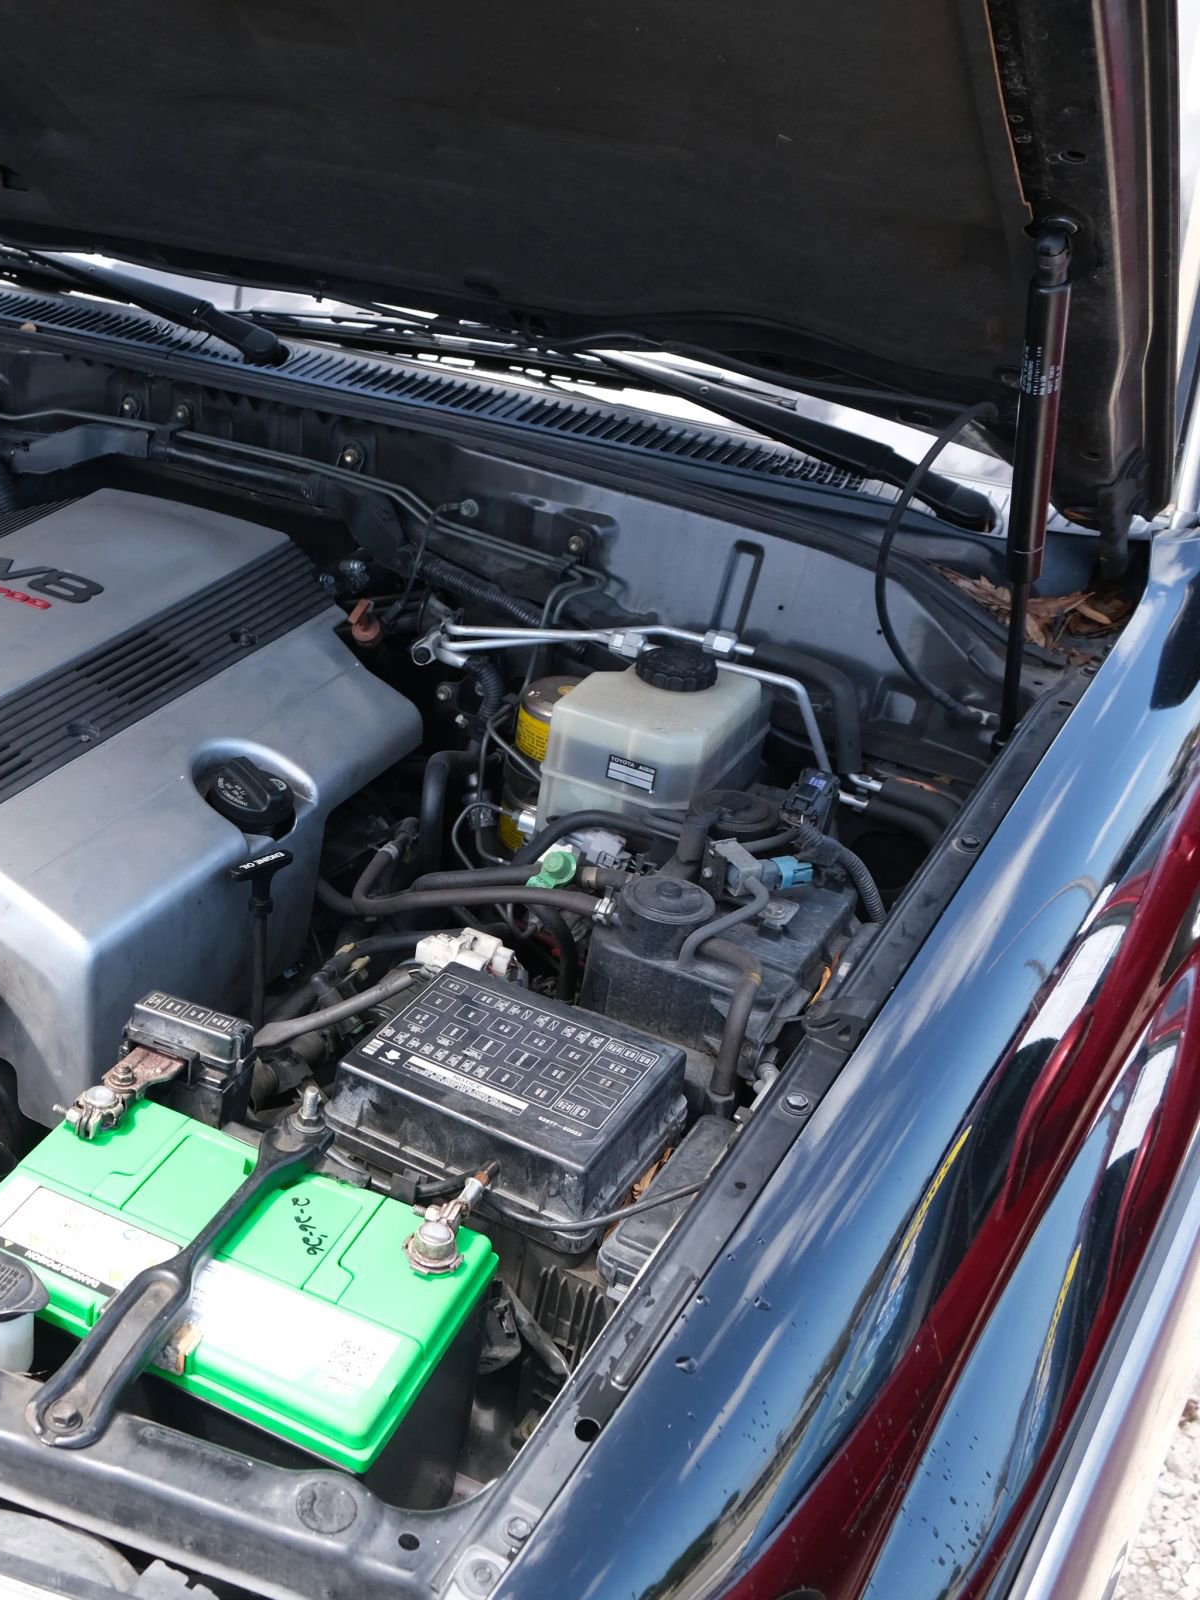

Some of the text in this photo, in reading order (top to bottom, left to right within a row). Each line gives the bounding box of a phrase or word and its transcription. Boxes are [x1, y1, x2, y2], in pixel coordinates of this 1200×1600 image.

[610, 756, 656, 775] TOYOTA AISIN
[238, 851, 286, 870] ENGINE OIL
